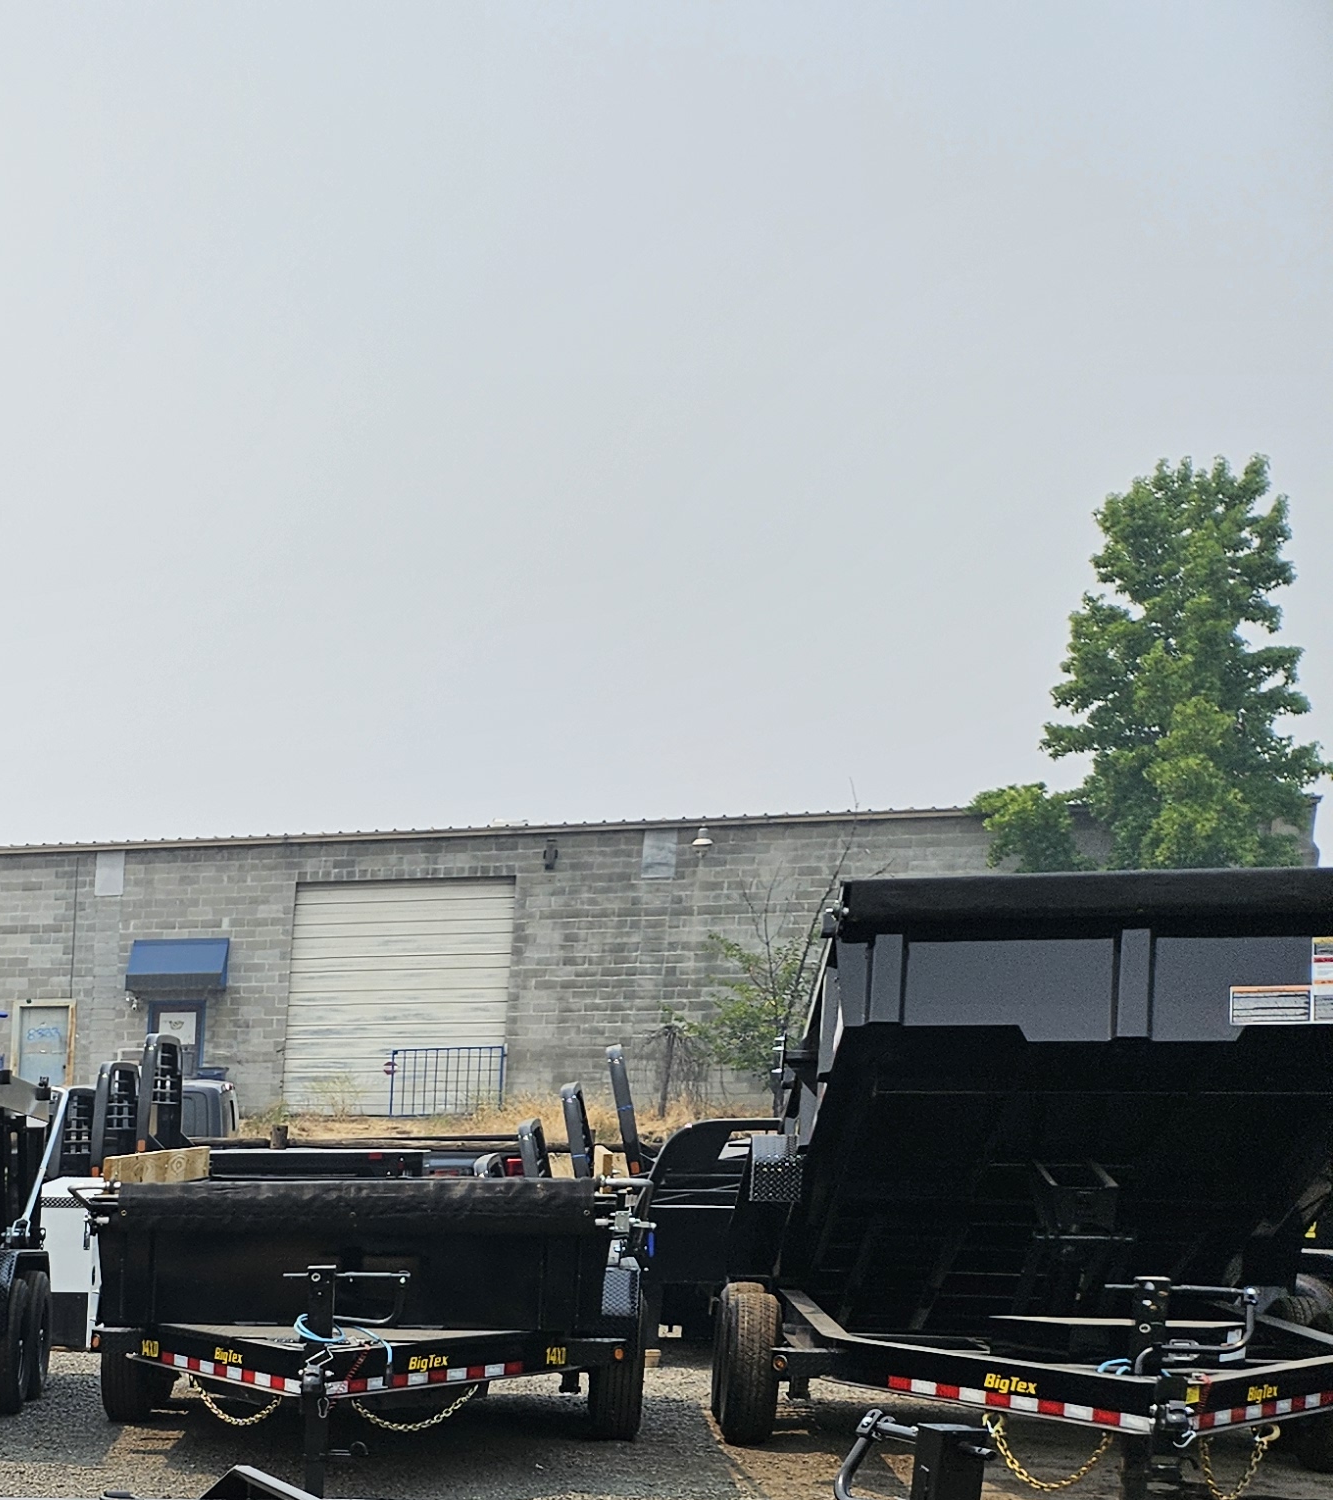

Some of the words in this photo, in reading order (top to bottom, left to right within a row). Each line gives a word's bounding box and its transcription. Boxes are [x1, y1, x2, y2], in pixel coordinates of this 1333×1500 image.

[214, 1346, 243, 1365] BigTex
[408, 1354, 449, 1372] BigTex
[983, 1373, 1038, 1394] BigTex
[1247, 1384, 1278, 1403] BigTex
